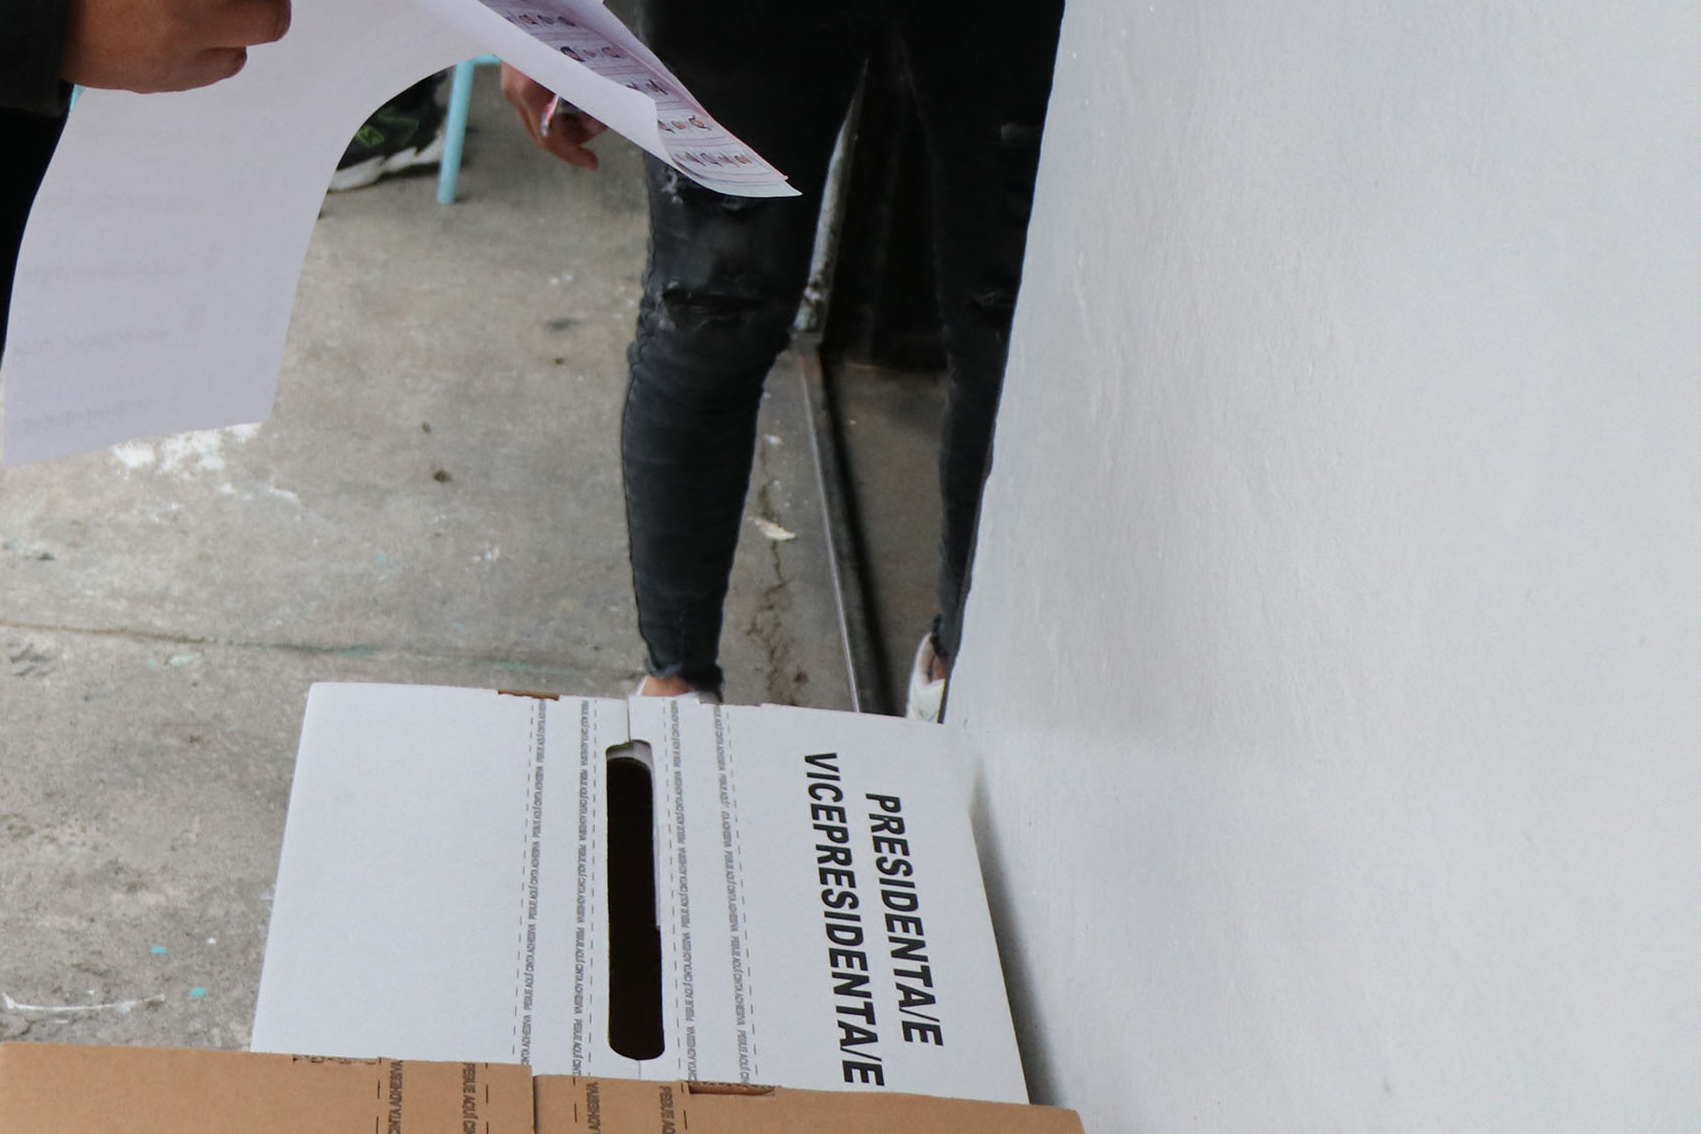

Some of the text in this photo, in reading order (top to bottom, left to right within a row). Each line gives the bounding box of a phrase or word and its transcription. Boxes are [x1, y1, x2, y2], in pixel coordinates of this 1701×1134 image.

[804, 752, 885, 1086] VICEPRESIDENTA/E
[865, 793, 944, 1047] PRESIDENTA/E
[463, 1062, 476, 1093] PEGUE
[571, 1060, 581, 1076] CINT
[462, 1095, 479, 1120] AQUÍ
[586, 1082, 601, 1132] ADHESIVA
[659, 1085, 674, 1119] PEGUE
